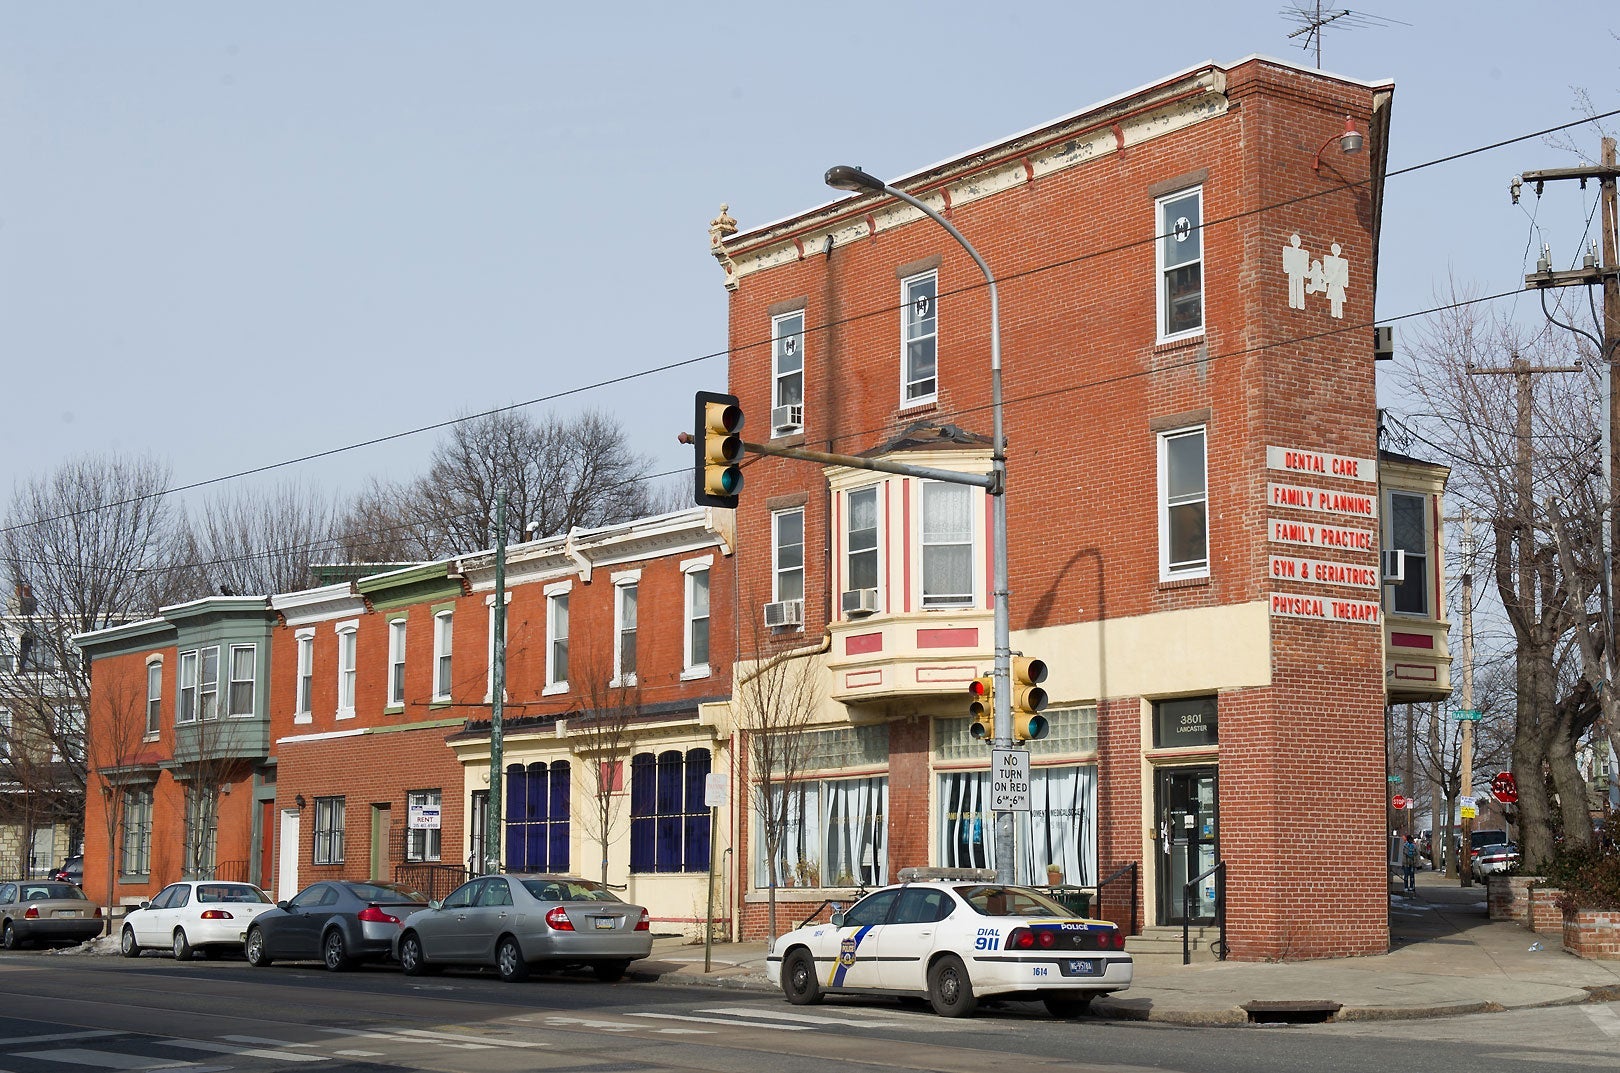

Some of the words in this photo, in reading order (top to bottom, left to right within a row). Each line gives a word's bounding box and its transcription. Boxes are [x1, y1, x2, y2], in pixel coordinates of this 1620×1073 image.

[1285, 451, 1326, 473] DENTAL
[1332, 458, 1358, 477] CARE
[1273, 487, 1313, 507] FAMILY
[1319, 493, 1372, 515] PLANNING
[1275, 523, 1315, 542] FAMILY
[1321, 528, 1371, 549] PRACTICE
[1273, 559, 1295, 578] GYN
[1301, 562, 1309, 579] &
[1315, 564, 1376, 586] GERIATRICS
[1272, 596, 1325, 617] PHYSICAL
[1332, 601, 1378, 621] THERAPY
[1180, 713, 1202, 724] 3801
[1176, 725, 1207, 733] LANCASTER
[1004, 756, 1018, 766] NO
[999, 769, 1022, 779] TURN
[994, 782, 1007, 792] ON
[1009, 782, 1028, 792] RED
[1061, 923, 1089, 931] POLICE
[977, 928, 1001, 937] DIAL
[974, 937, 1000, 951] 911
[1032, 967, 1048, 976] 1614
